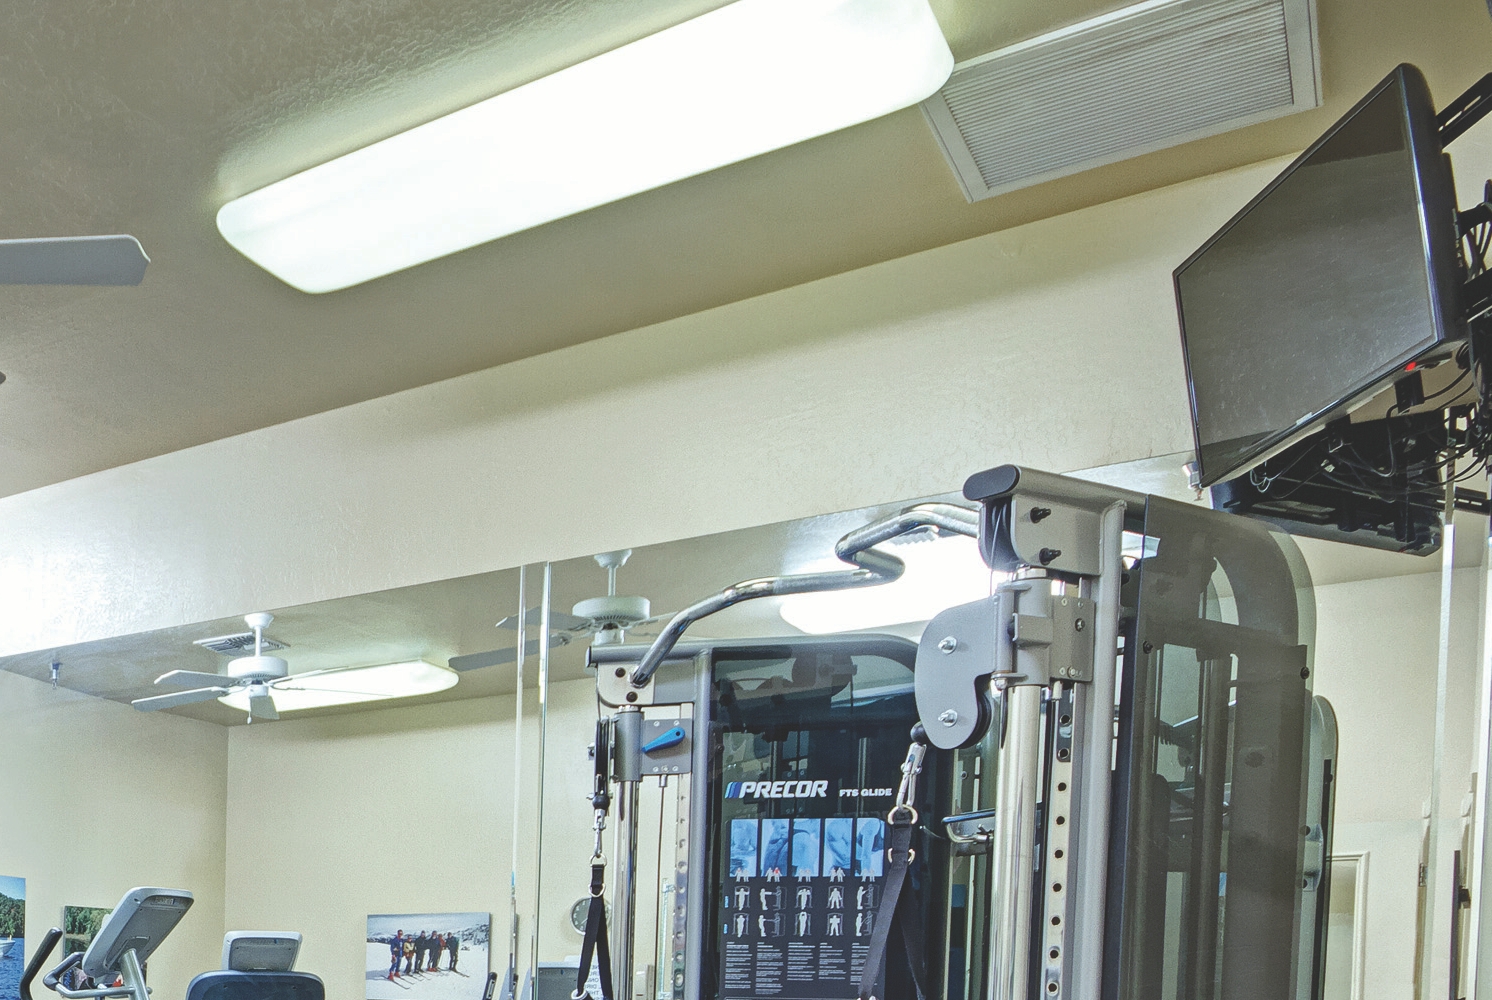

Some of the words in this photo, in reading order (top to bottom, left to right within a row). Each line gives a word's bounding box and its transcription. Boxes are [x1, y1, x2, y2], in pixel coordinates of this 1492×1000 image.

[739, 780, 828, 798] PRECOR
[839, 789, 859, 797] FTS
[861, 788, 893, 797] GLIDE
